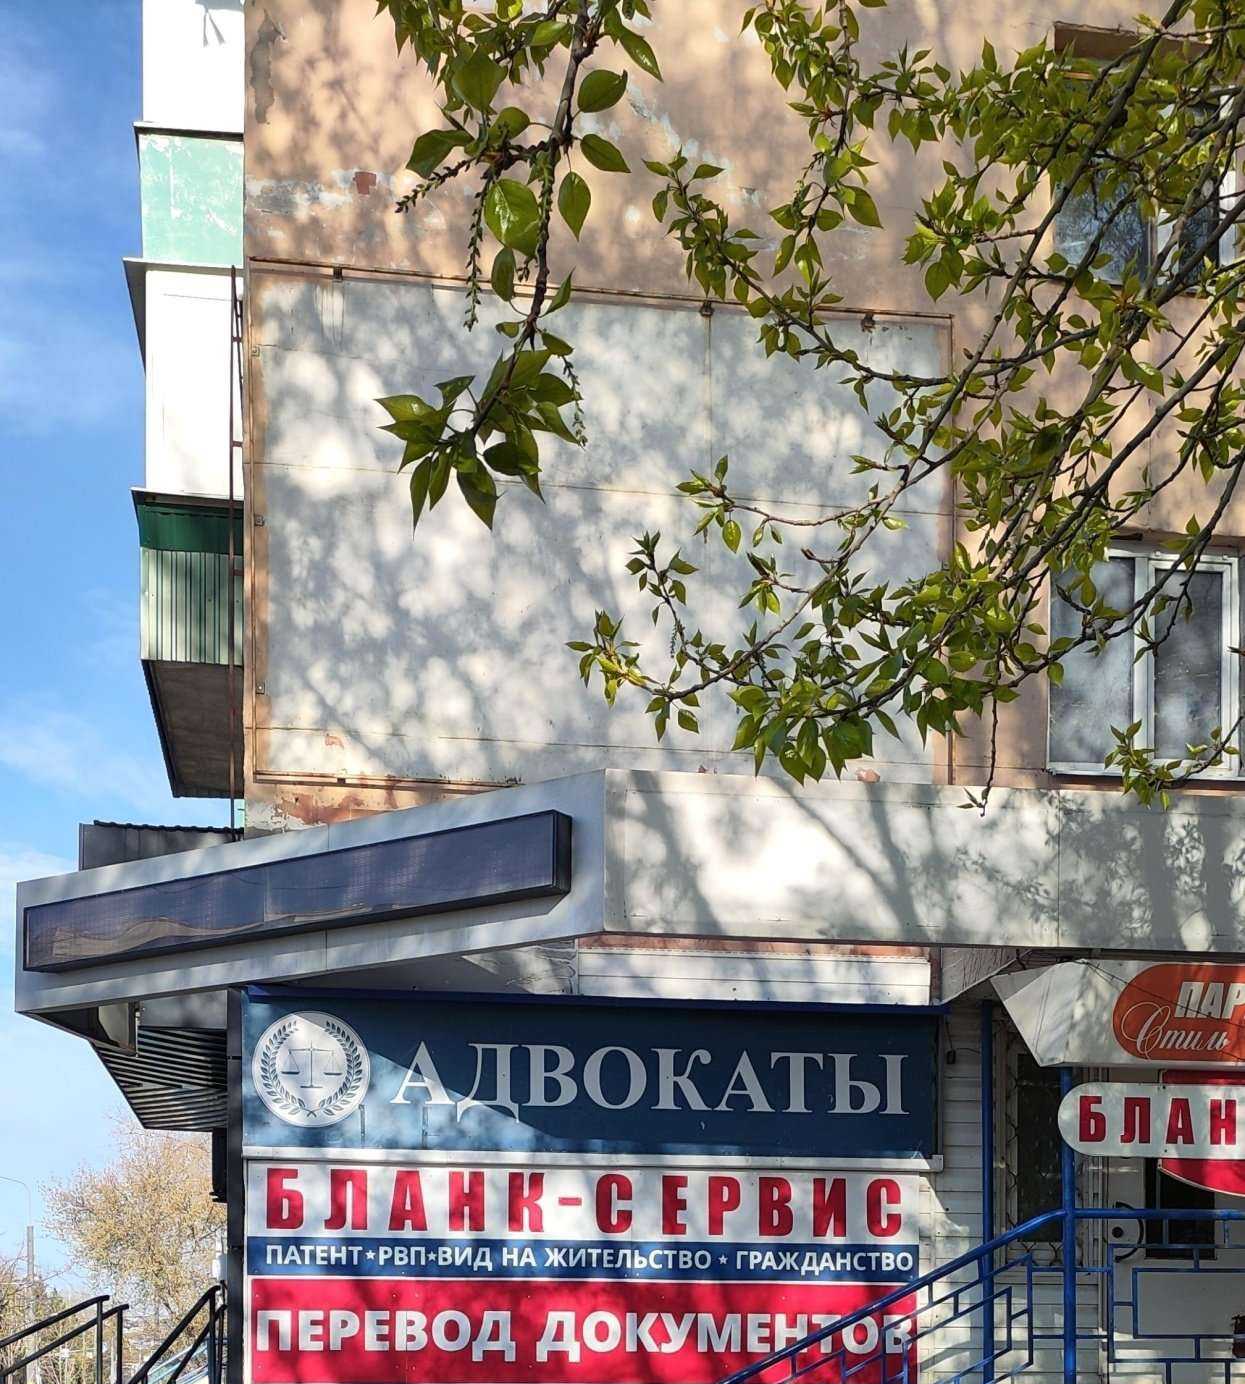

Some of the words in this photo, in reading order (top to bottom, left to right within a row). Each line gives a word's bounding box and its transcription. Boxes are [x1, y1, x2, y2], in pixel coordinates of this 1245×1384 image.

[1121, 1001, 1229, 1060] Стиль
[389, 1040, 911, 1122] АДВОКАТЫ
[1078, 1095, 1238, 1146] БЛАН
[265, 1167, 904, 1238] БЛАНК-СЕРВИС
[265, 1244, 363, 1266] ПАТЕНТ
[502, 1247, 537, 1267] НА
[544, 1247, 712, 1271] ЖИТЕЛЬСТВО
[735, 1250, 914, 1276] ГРАЖДАНСТВО
[256, 1309, 517, 1362] ПЕРЕВОД
[535, 1309, 914, 1363] ДОКУМЕНТОВ
